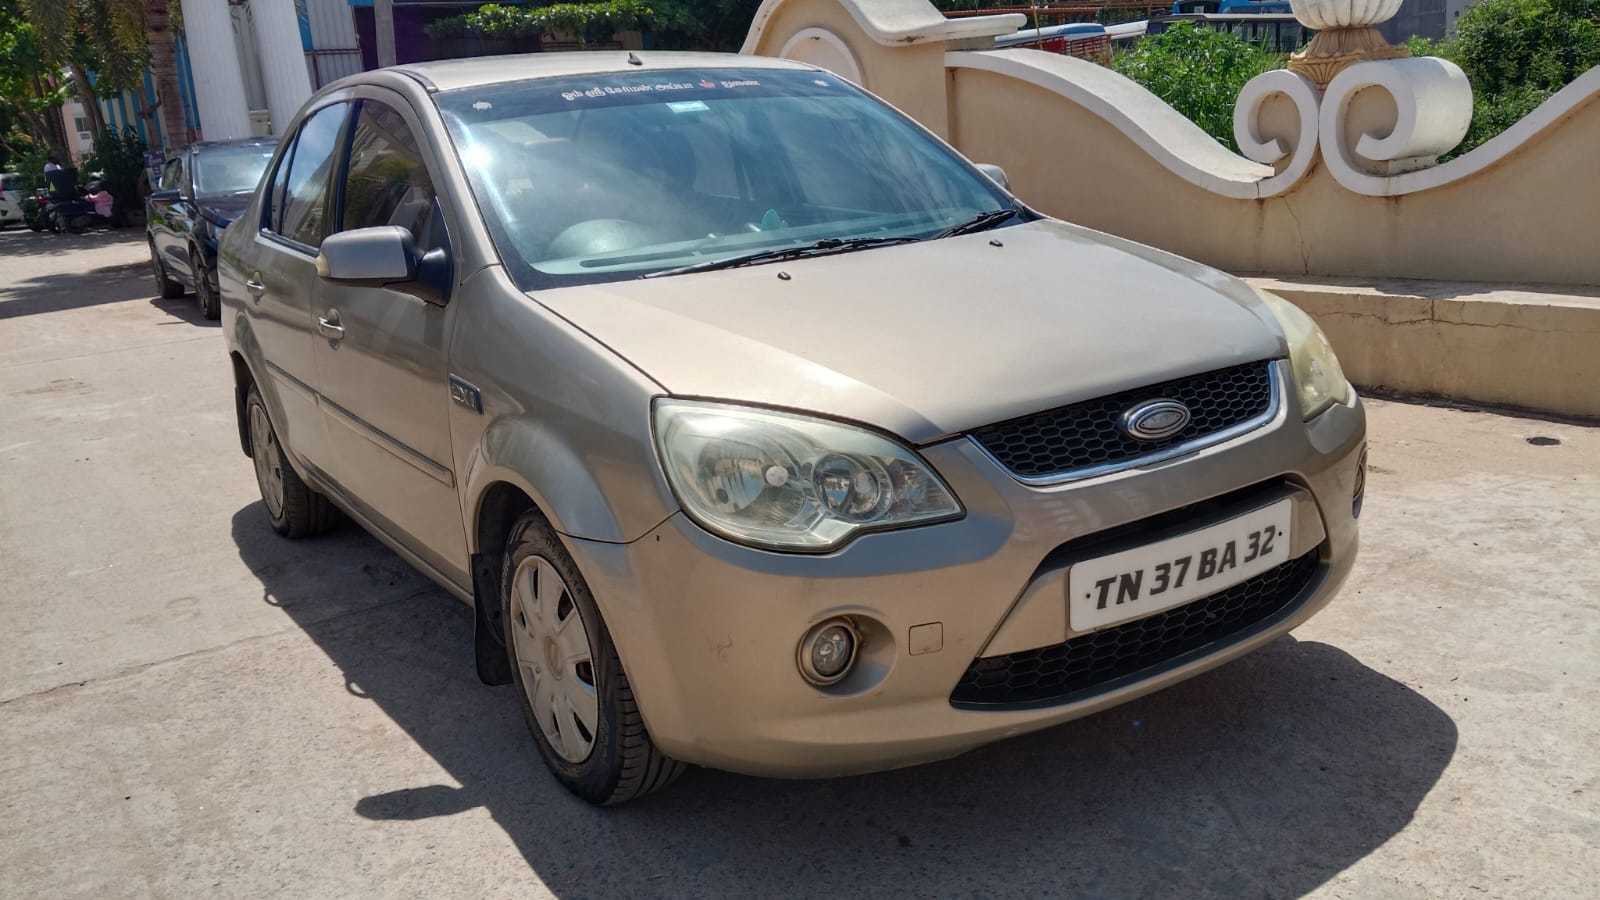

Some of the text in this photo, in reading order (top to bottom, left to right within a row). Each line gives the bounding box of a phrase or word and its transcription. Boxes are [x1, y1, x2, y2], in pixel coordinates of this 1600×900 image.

[1095, 524, 1276, 610] TN 37 BA 32
